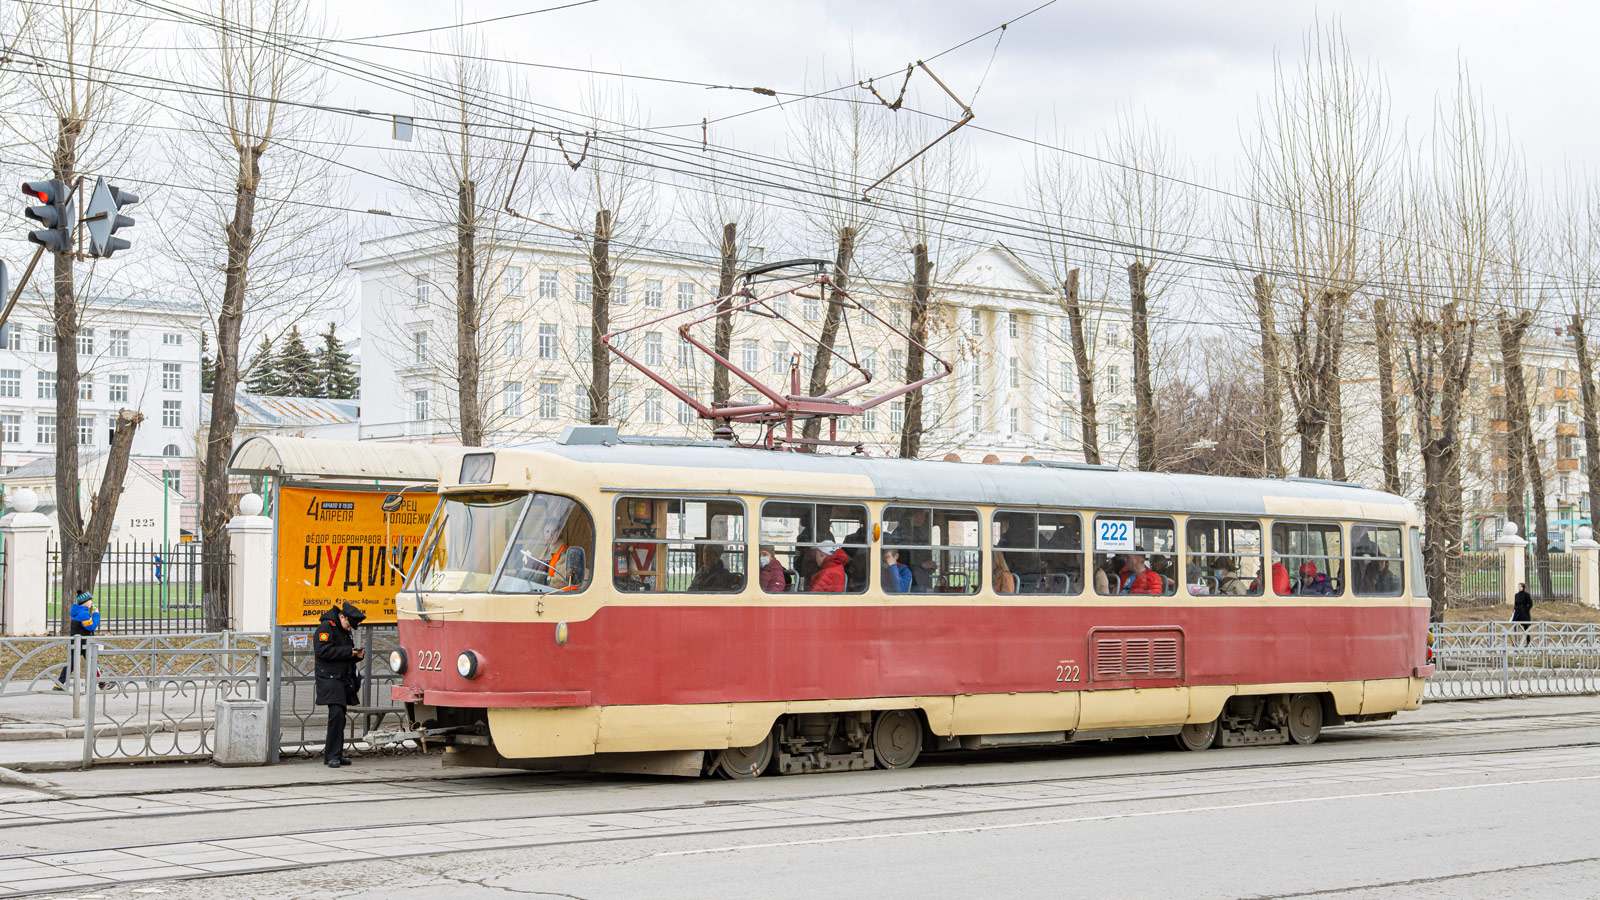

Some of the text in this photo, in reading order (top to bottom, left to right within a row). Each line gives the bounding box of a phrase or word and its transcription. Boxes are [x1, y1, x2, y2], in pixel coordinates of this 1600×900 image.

[307, 496, 319, 520] 4
[320, 510, 354, 522] АПРЕЛЯ
[130, 518, 155, 527] 1225
[306, 532, 329, 545] ФЁДОР
[332, 534, 382, 545] ДОБРОНРАВОВ
[391, 535, 424, 545] СПЕКТАК
[1101, 522, 1127, 541] 222
[304, 545, 417, 592] ЧУДИК
[303, 597, 331, 606] kassy.ru
[418, 650, 442, 671] 222
[1056, 665, 1080, 682] 222
